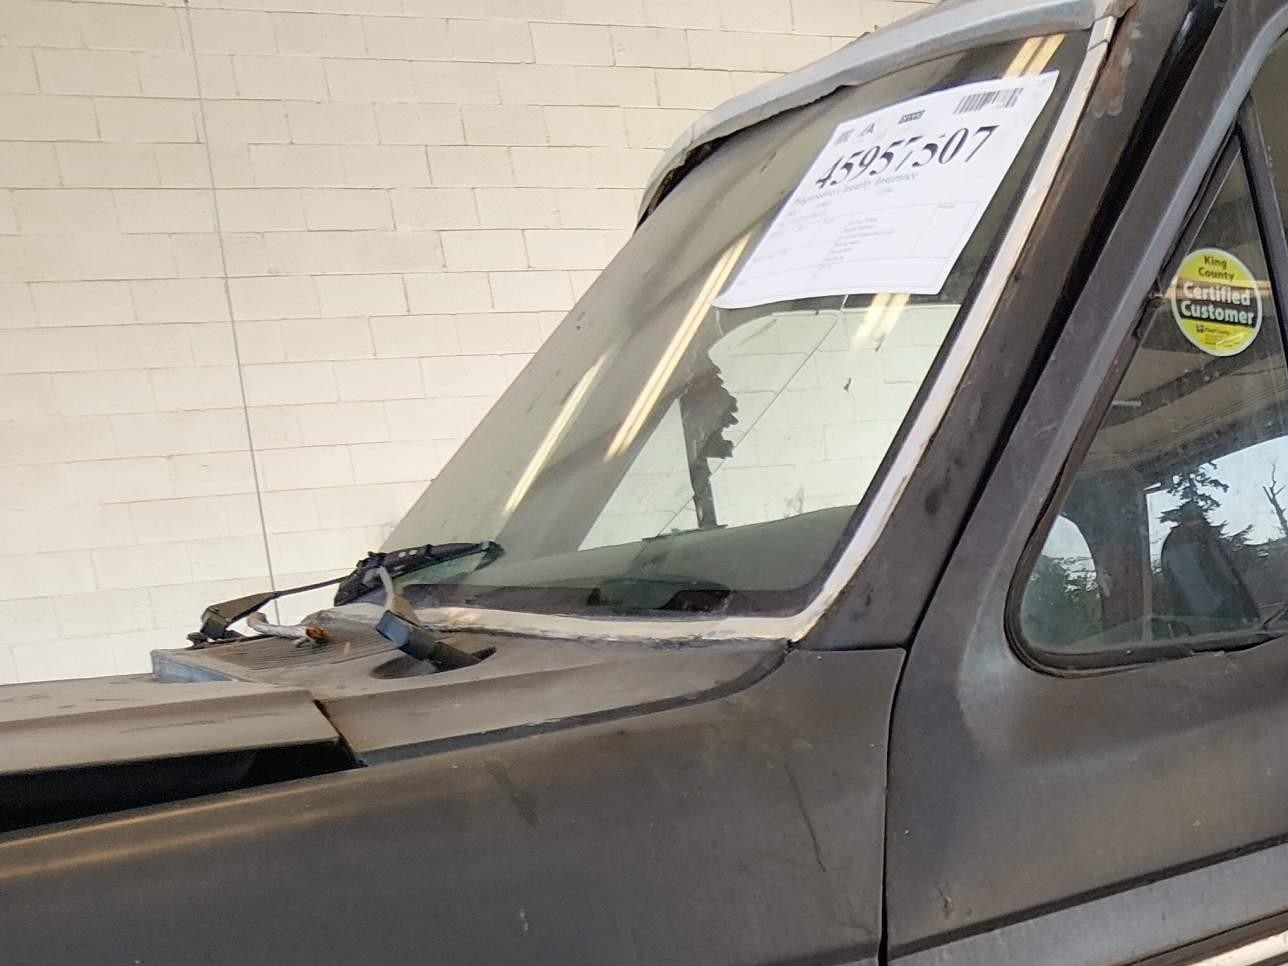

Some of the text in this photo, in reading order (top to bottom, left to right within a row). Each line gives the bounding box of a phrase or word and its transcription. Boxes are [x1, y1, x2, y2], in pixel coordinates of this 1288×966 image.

[1204, 256, 1227, 269] King
[1198, 268, 1234, 281] County
[1183, 282, 1251, 306] Certified
[1181, 301, 1255, 325] Customer
